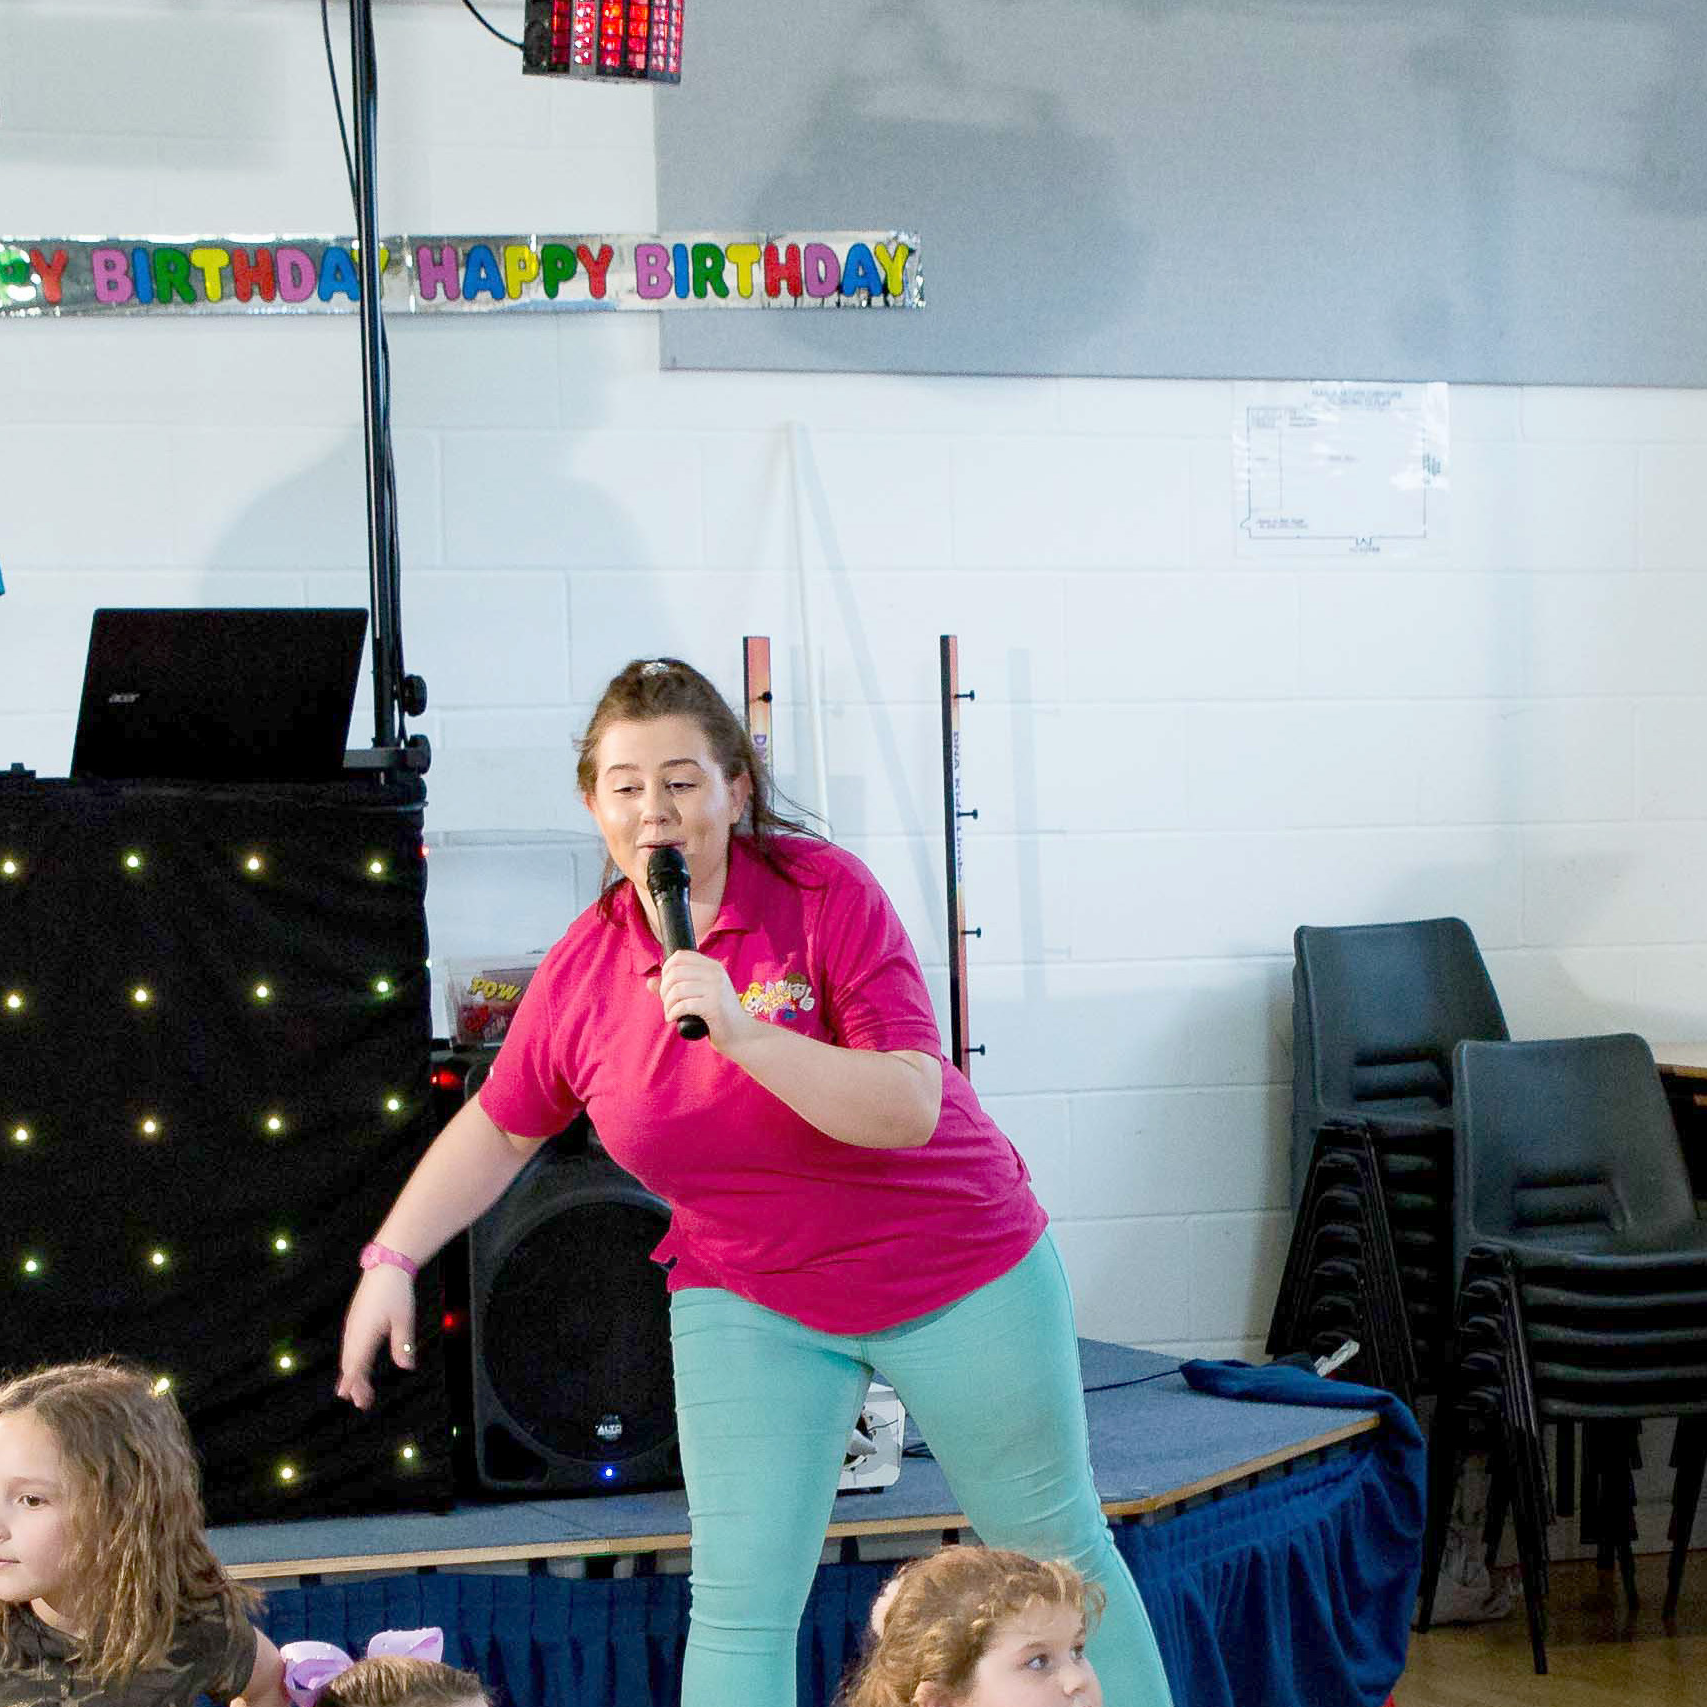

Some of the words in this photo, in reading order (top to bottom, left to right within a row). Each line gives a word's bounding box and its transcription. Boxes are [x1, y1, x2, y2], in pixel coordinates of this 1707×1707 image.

[418, 241, 614, 304] HAPPY
[635, 242, 910, 304] BIRTHDAY
[467, 975, 524, 1002] POW
